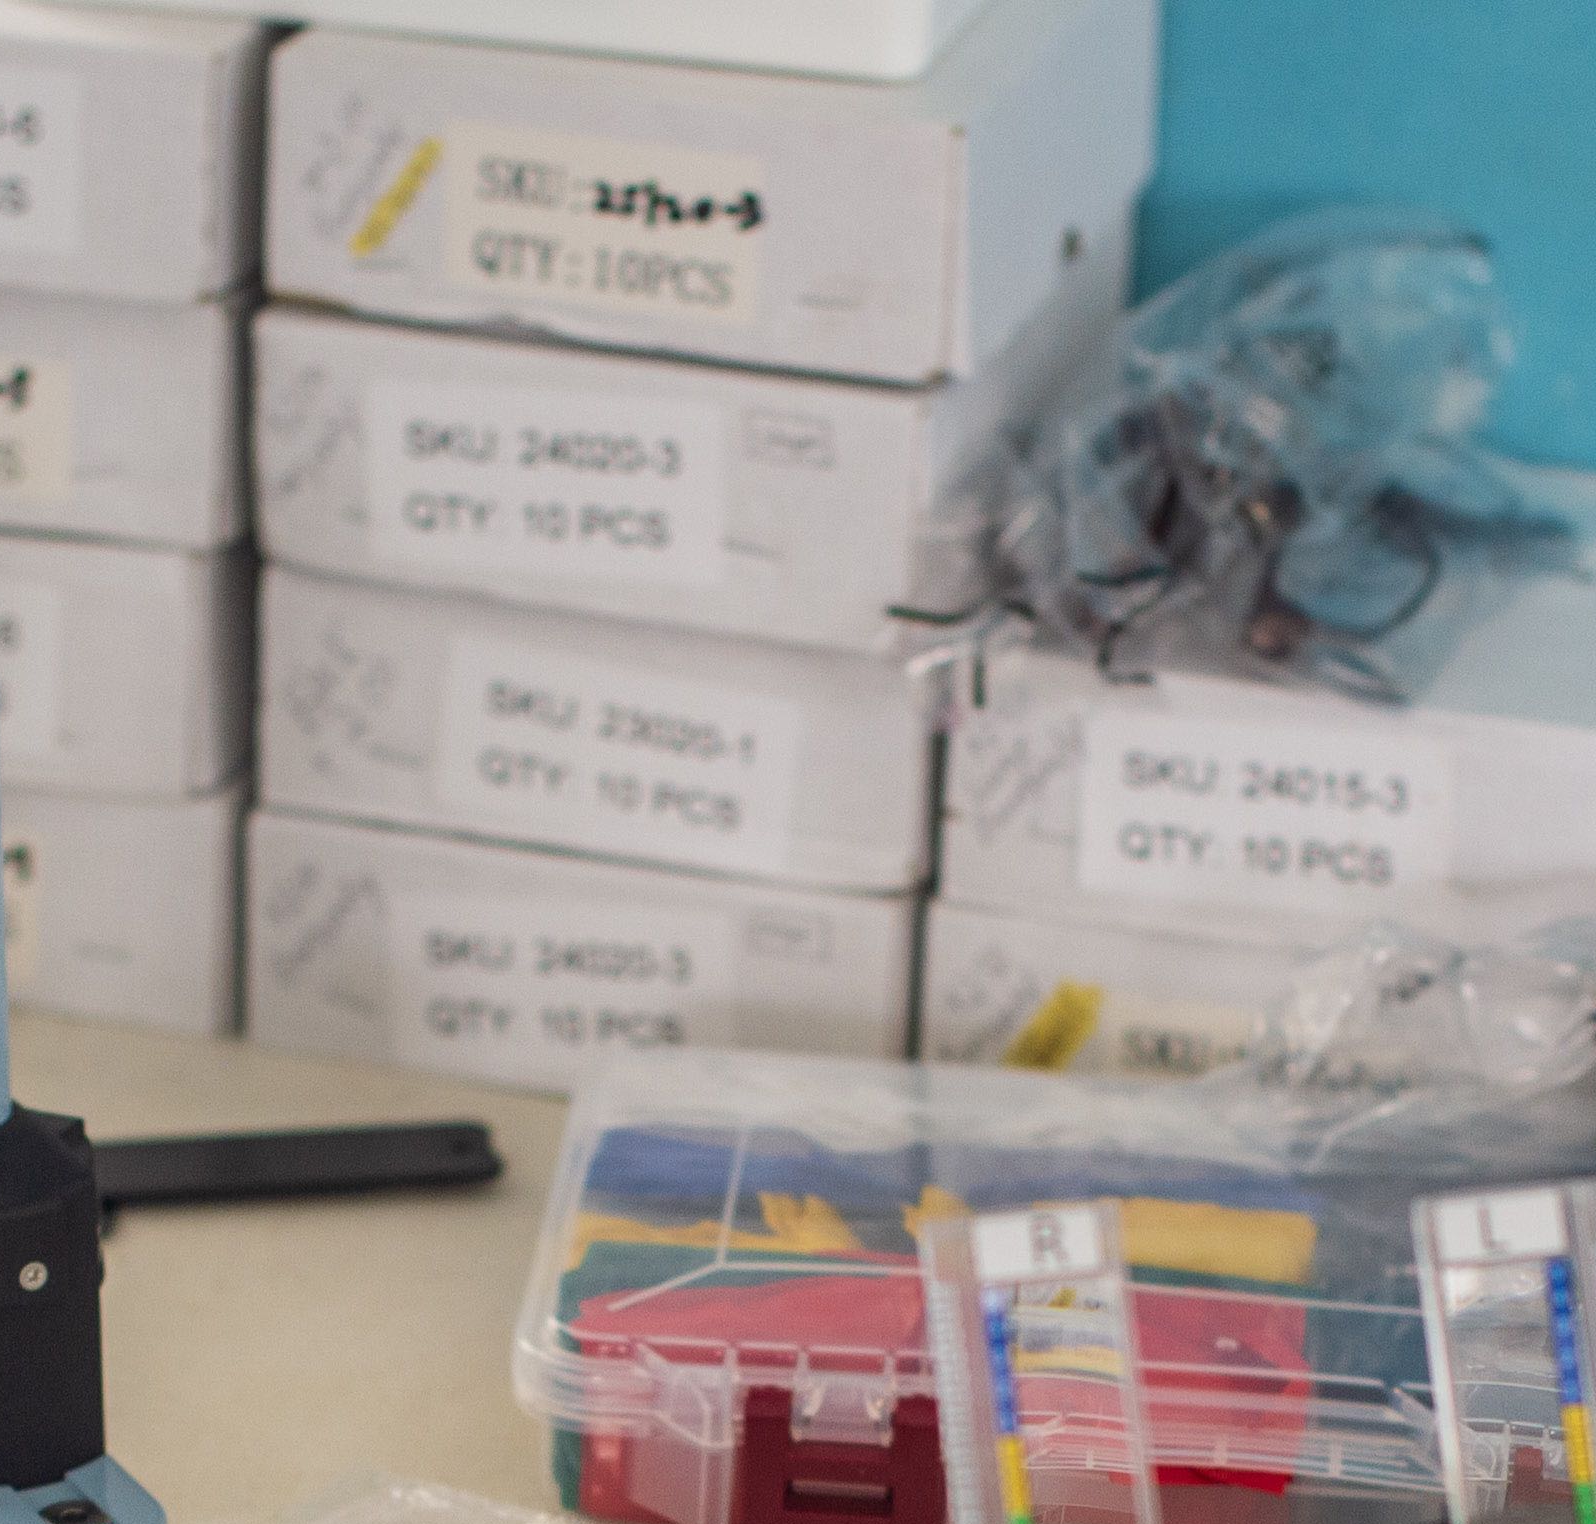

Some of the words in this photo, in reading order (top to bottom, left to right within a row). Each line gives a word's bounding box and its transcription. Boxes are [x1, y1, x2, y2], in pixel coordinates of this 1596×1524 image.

[580, 510, 674, 550] PCS
[652, 784, 742, 832] PCS
[1298, 842, 1394, 886] PCS
[1028, 1211, 1070, 1268] R
[1480, 1201, 1511, 1251] L
